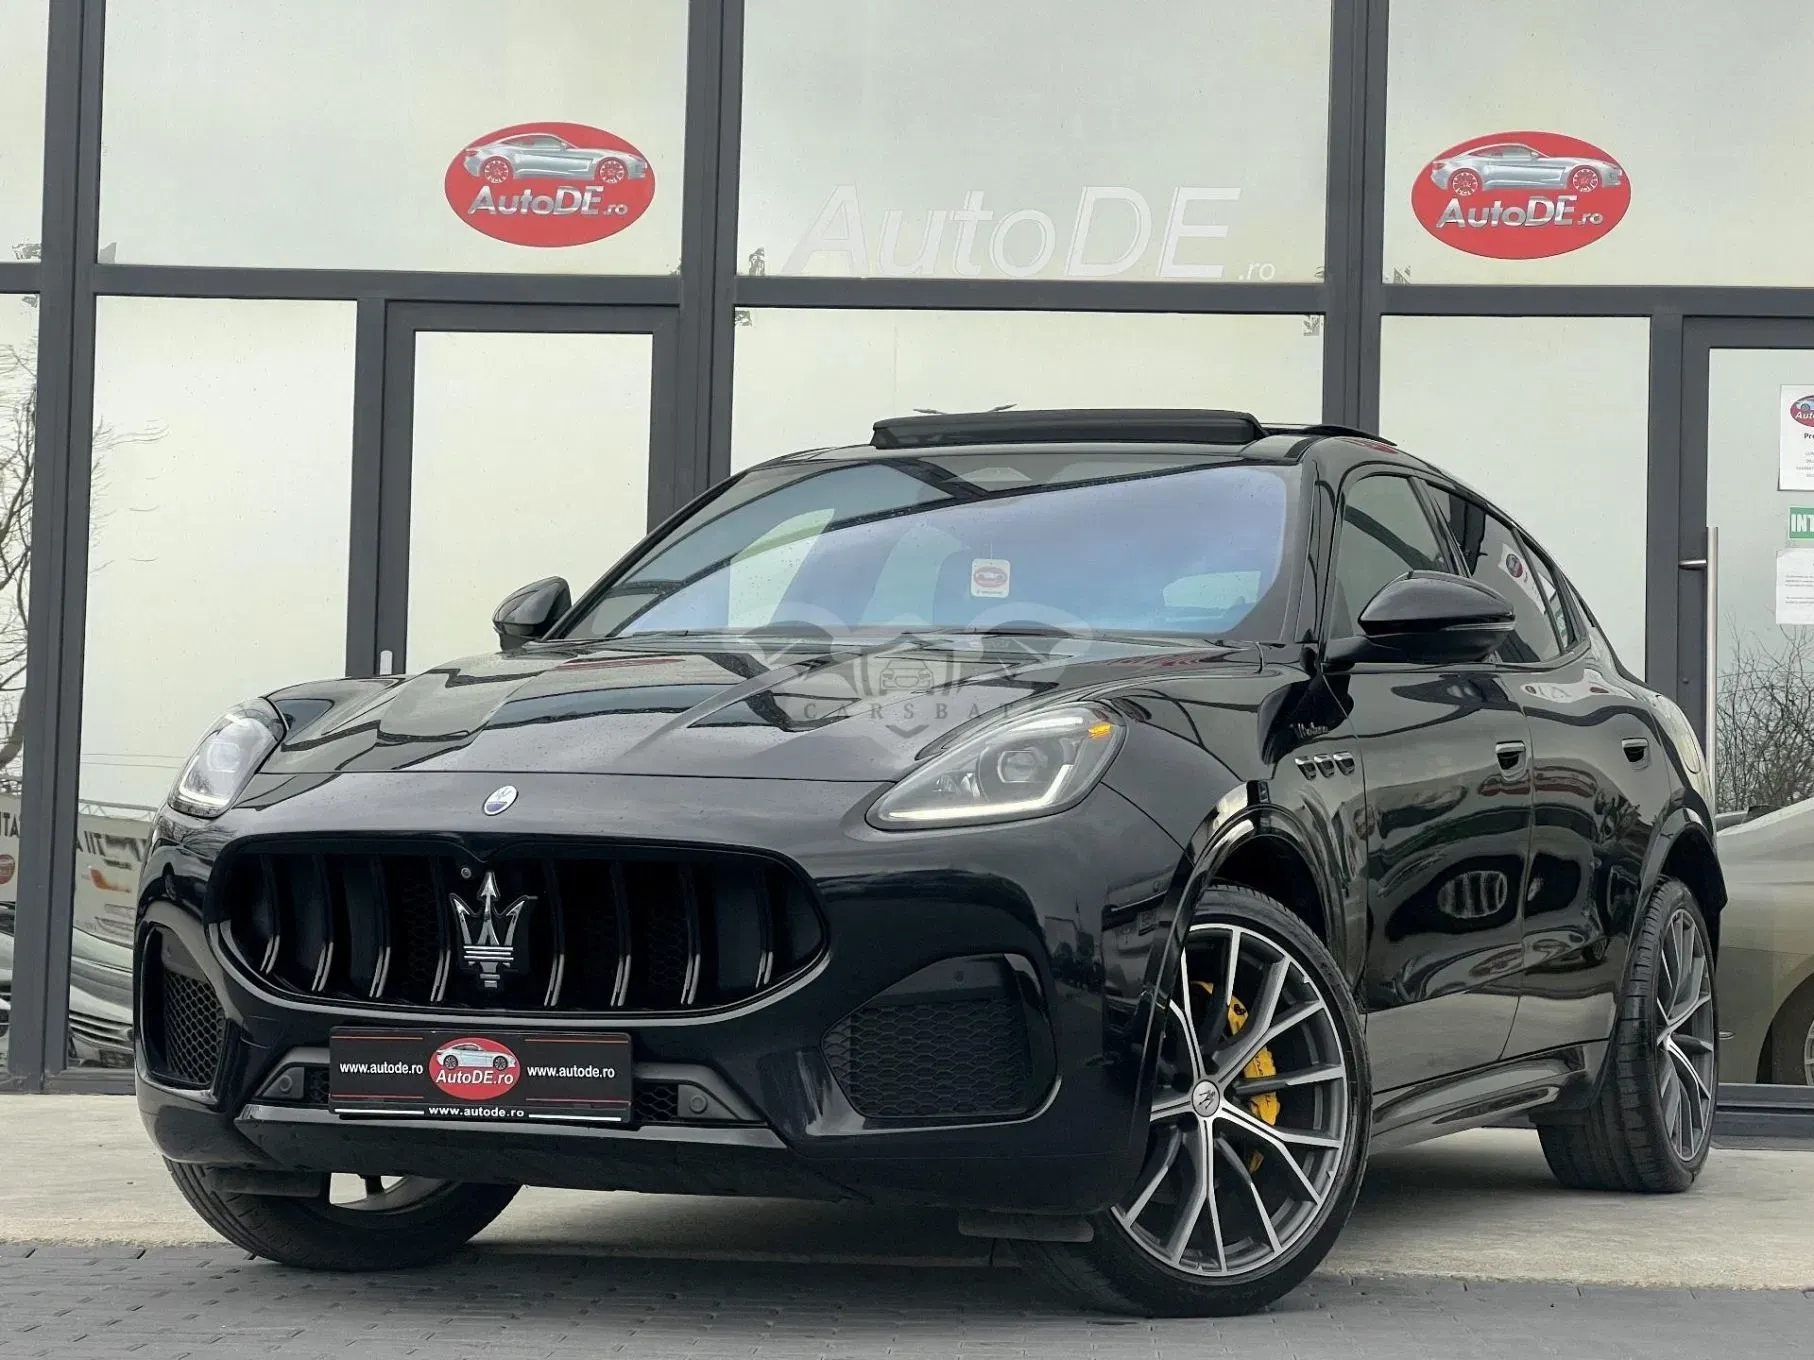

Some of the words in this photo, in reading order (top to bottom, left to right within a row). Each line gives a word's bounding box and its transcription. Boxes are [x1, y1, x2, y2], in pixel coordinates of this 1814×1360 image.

[340, 1061, 424, 1075] www.autode.ro
[527, 1064, 615, 1079] www.autode.ro
[435, 1069, 514, 1085] AutoDE.ro
[428, 1106, 525, 1118] www.autode.ro
